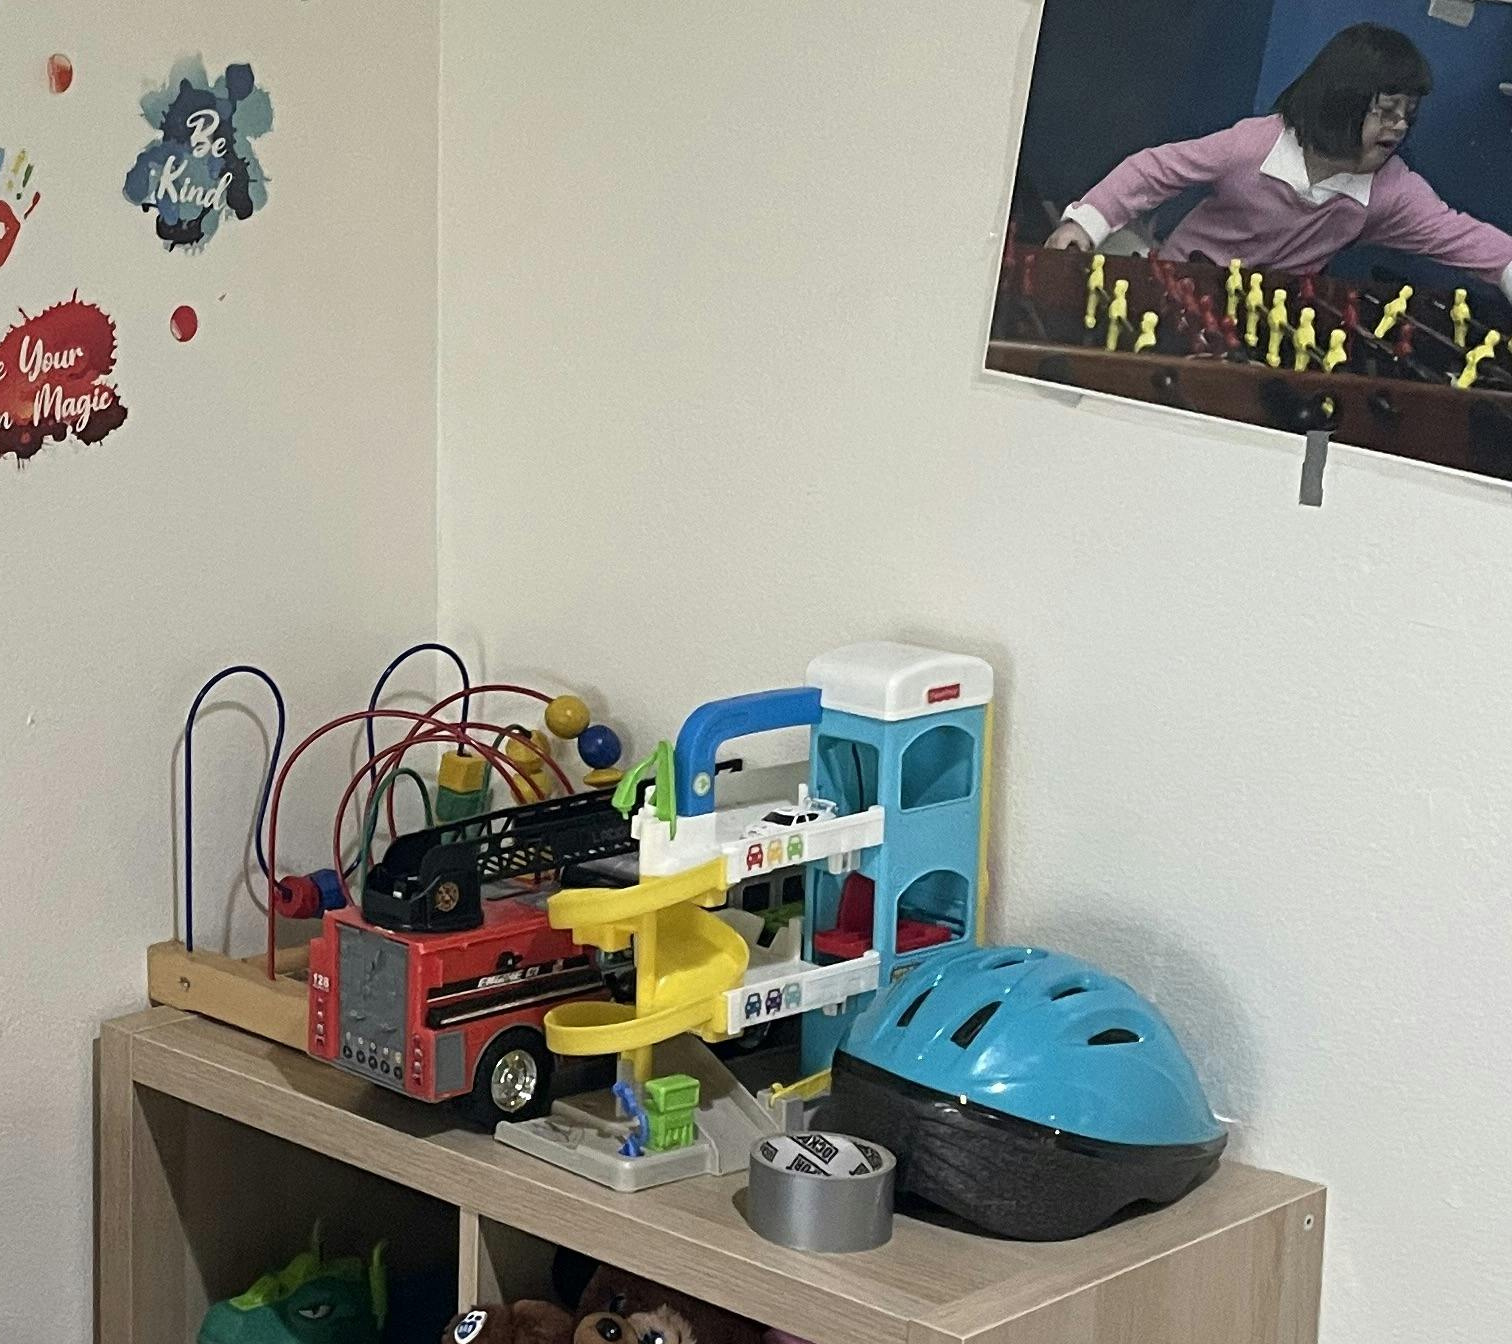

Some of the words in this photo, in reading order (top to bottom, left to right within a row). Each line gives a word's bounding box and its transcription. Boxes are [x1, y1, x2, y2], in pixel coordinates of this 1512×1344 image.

[187, 109, 227, 158] Be
[157, 156, 233, 209] Kind
[19, 335, 84, 383] Your
[33, 383, 113, 432] Magic
